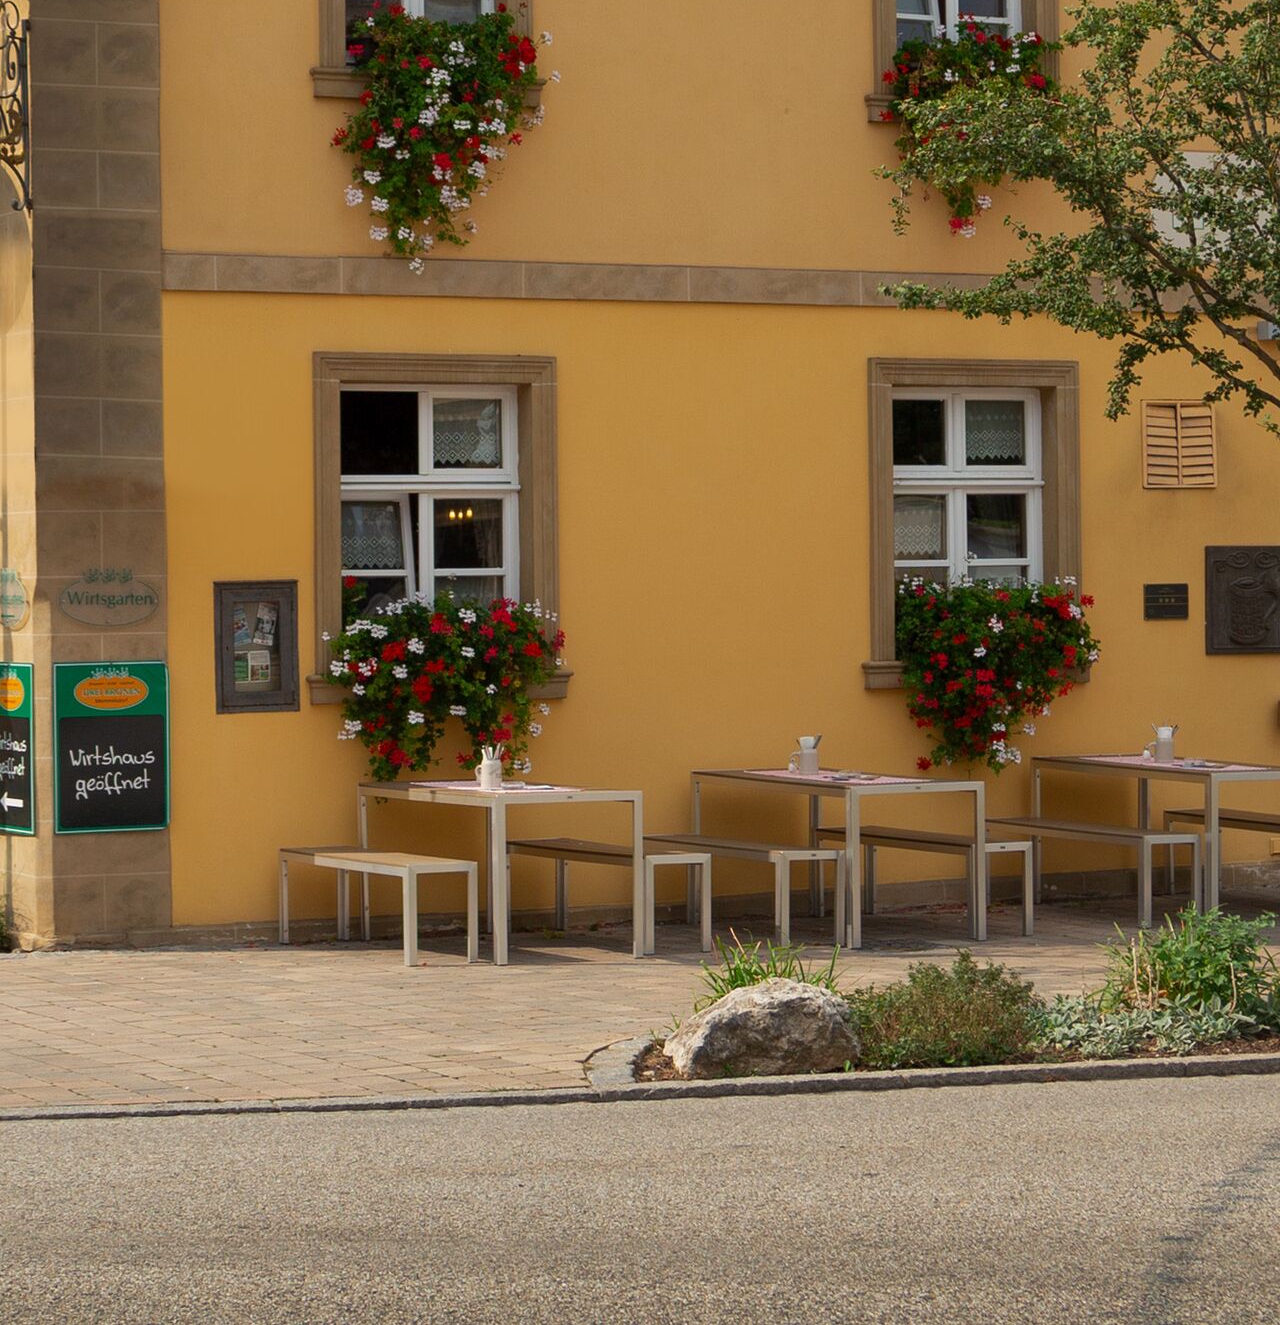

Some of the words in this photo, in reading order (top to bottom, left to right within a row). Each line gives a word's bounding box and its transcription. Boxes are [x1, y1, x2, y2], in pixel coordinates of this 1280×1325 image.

[67, 590, 154, 608] Wirtsgarten
[69, 745, 156, 767] Wirtshaus
[75, 768, 151, 801] geöffnet
